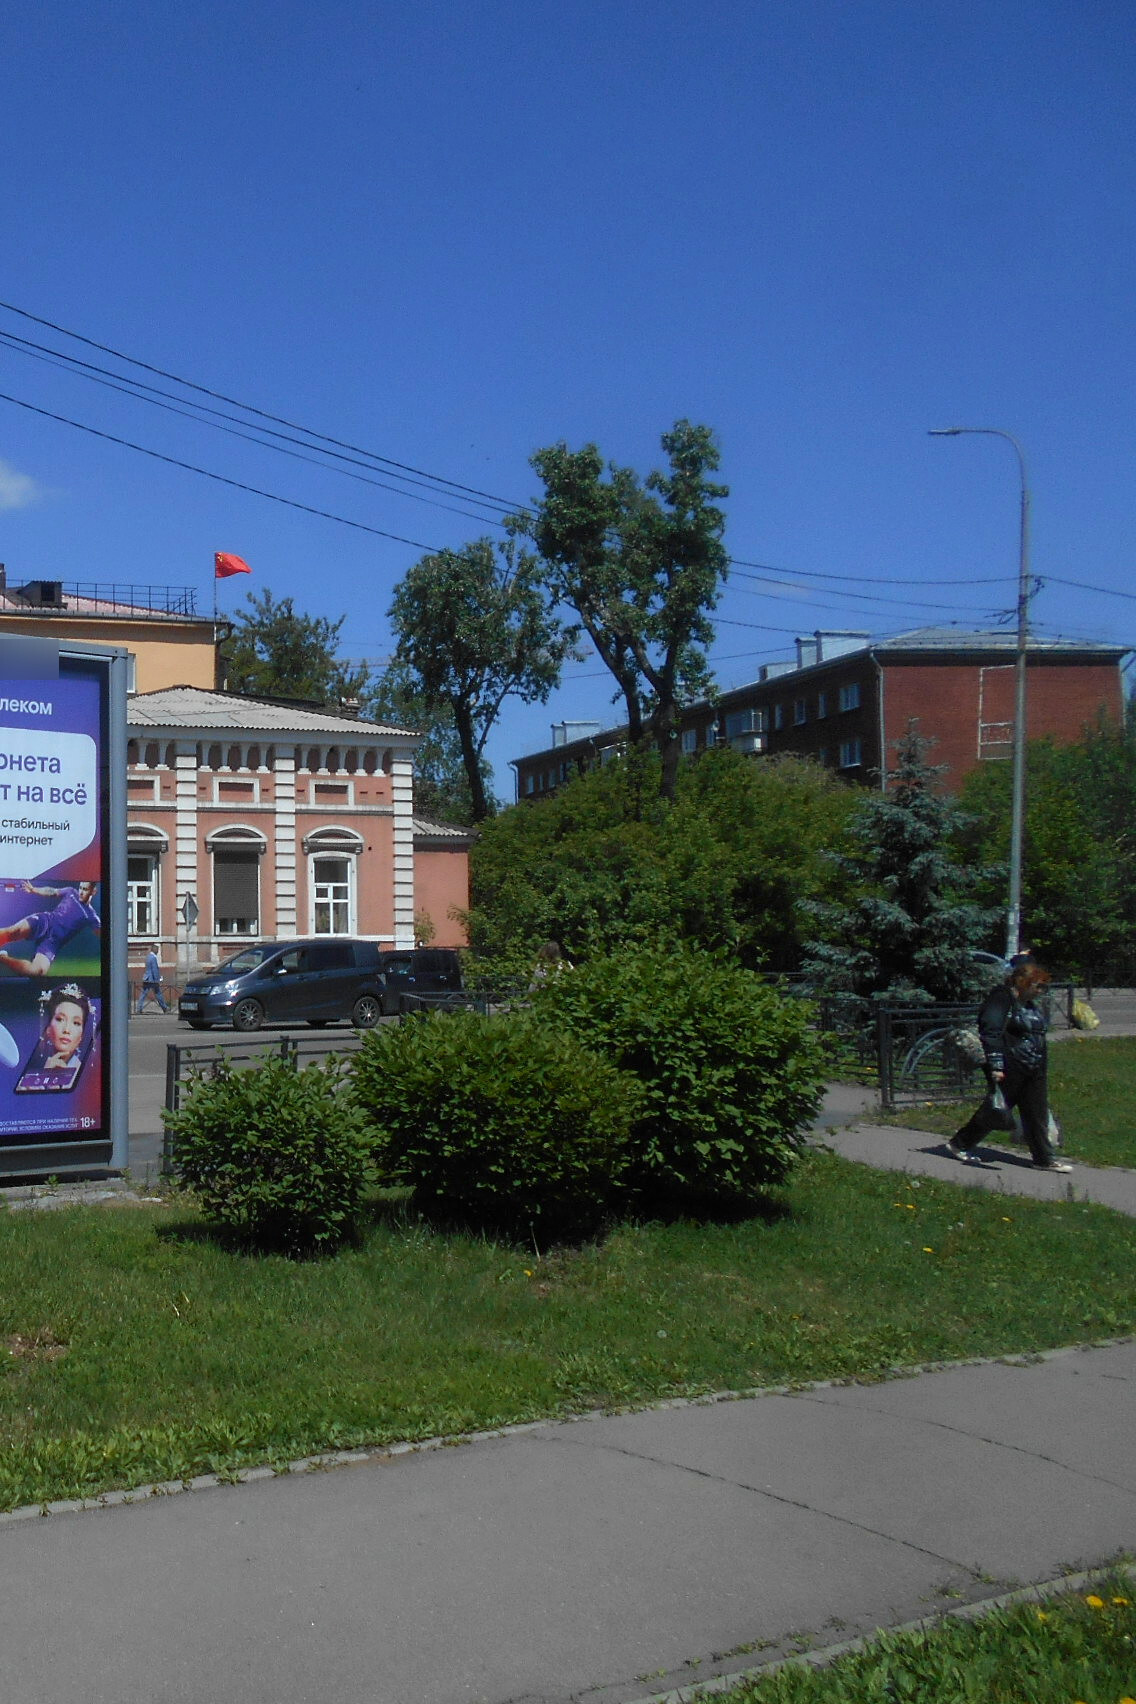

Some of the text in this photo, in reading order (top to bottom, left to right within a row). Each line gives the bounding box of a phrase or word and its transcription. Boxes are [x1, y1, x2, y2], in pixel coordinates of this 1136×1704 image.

[17, 785, 44, 803] на
[50, 783, 88, 805] всё
[1, 818, 70, 831] стабильный
[0, 834, 53, 846] интернет
[80, 1116, 96, 1128] 18+
